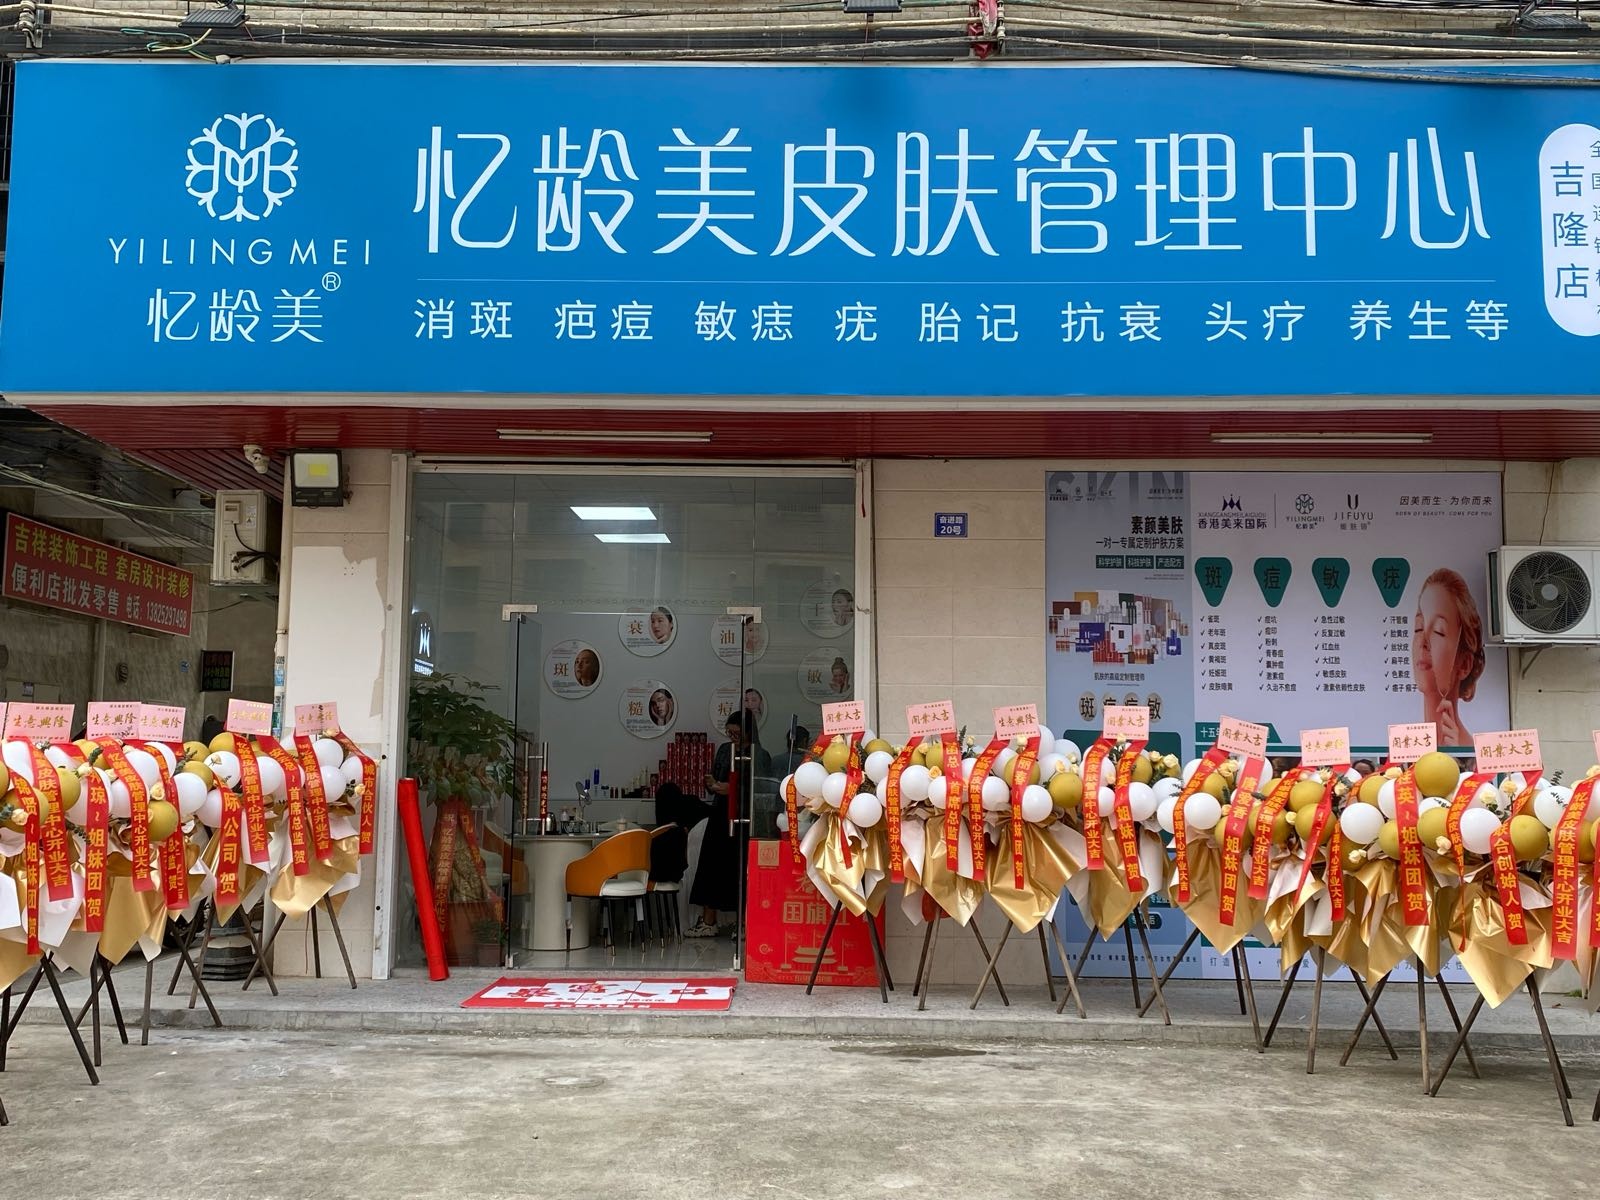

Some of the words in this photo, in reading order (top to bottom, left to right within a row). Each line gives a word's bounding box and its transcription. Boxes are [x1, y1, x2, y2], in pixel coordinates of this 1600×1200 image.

[413, 126, 1491, 257] 忆龄美皮肤管理中心
[1550, 160, 1590, 299] 吉隆店
[413, 298, 513, 341] 消斑
[553, 299, 654, 341] 疤痘
[694, 300, 793, 342] 敏痣
[834, 301, 878, 342] 疣
[918, 301, 1019, 343] 胎记
[1061, 301, 1162, 343] 抗衰
[1205, 301, 1306, 343] 头疗
[1349, 300, 1509, 342] 养生等
[1131, 515, 1183, 534] 素颜美肤
[1198, 518, 1267, 530] 香港美来国际
[1333, 511, 1374, 521] JIFUYU
[940, 525, 962, 535] 20号
[15, 523, 109, 577] 吉祥装饰工程
[115, 555, 190, 599] 套房设计装修
[1205, 565, 1223, 588] 斑
[1263, 566, 1282, 589] 痘
[1322, 566, 1340, 589] 敏
[1383, 566, 1401, 589] 疣
[11, 561, 120, 616] 便利店批发零售
[719, 629, 735, 645] 油
[553, 662, 569, 677] 斑
[1081, 697, 1095, 718] 斑
